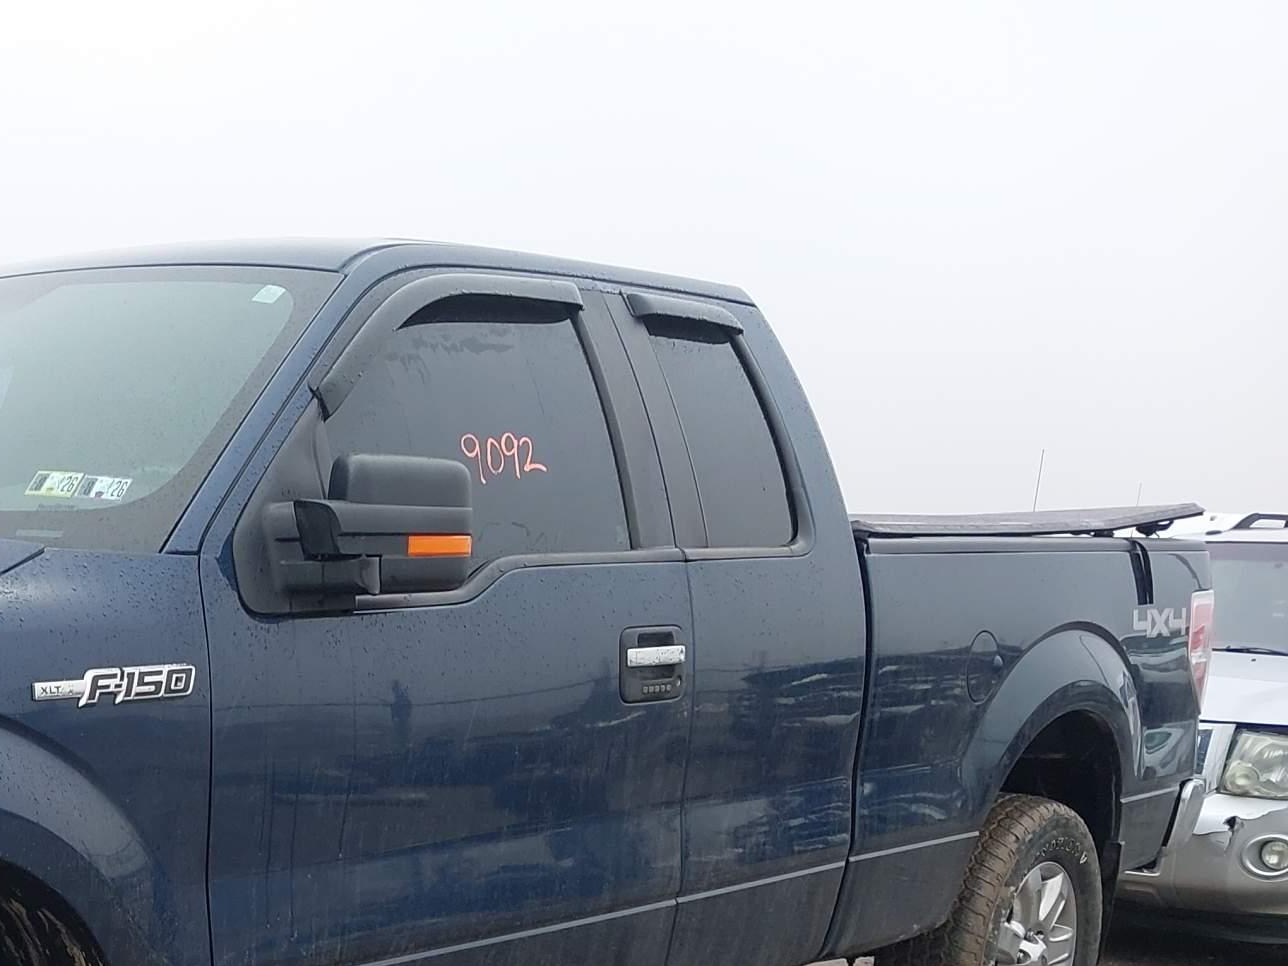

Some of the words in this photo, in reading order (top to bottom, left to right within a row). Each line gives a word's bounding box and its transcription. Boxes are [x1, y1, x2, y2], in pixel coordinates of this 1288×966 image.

[456, 426, 548, 485] 9092
[39, 685, 63, 696] XLT
[74, 663, 196, 708] F-150
